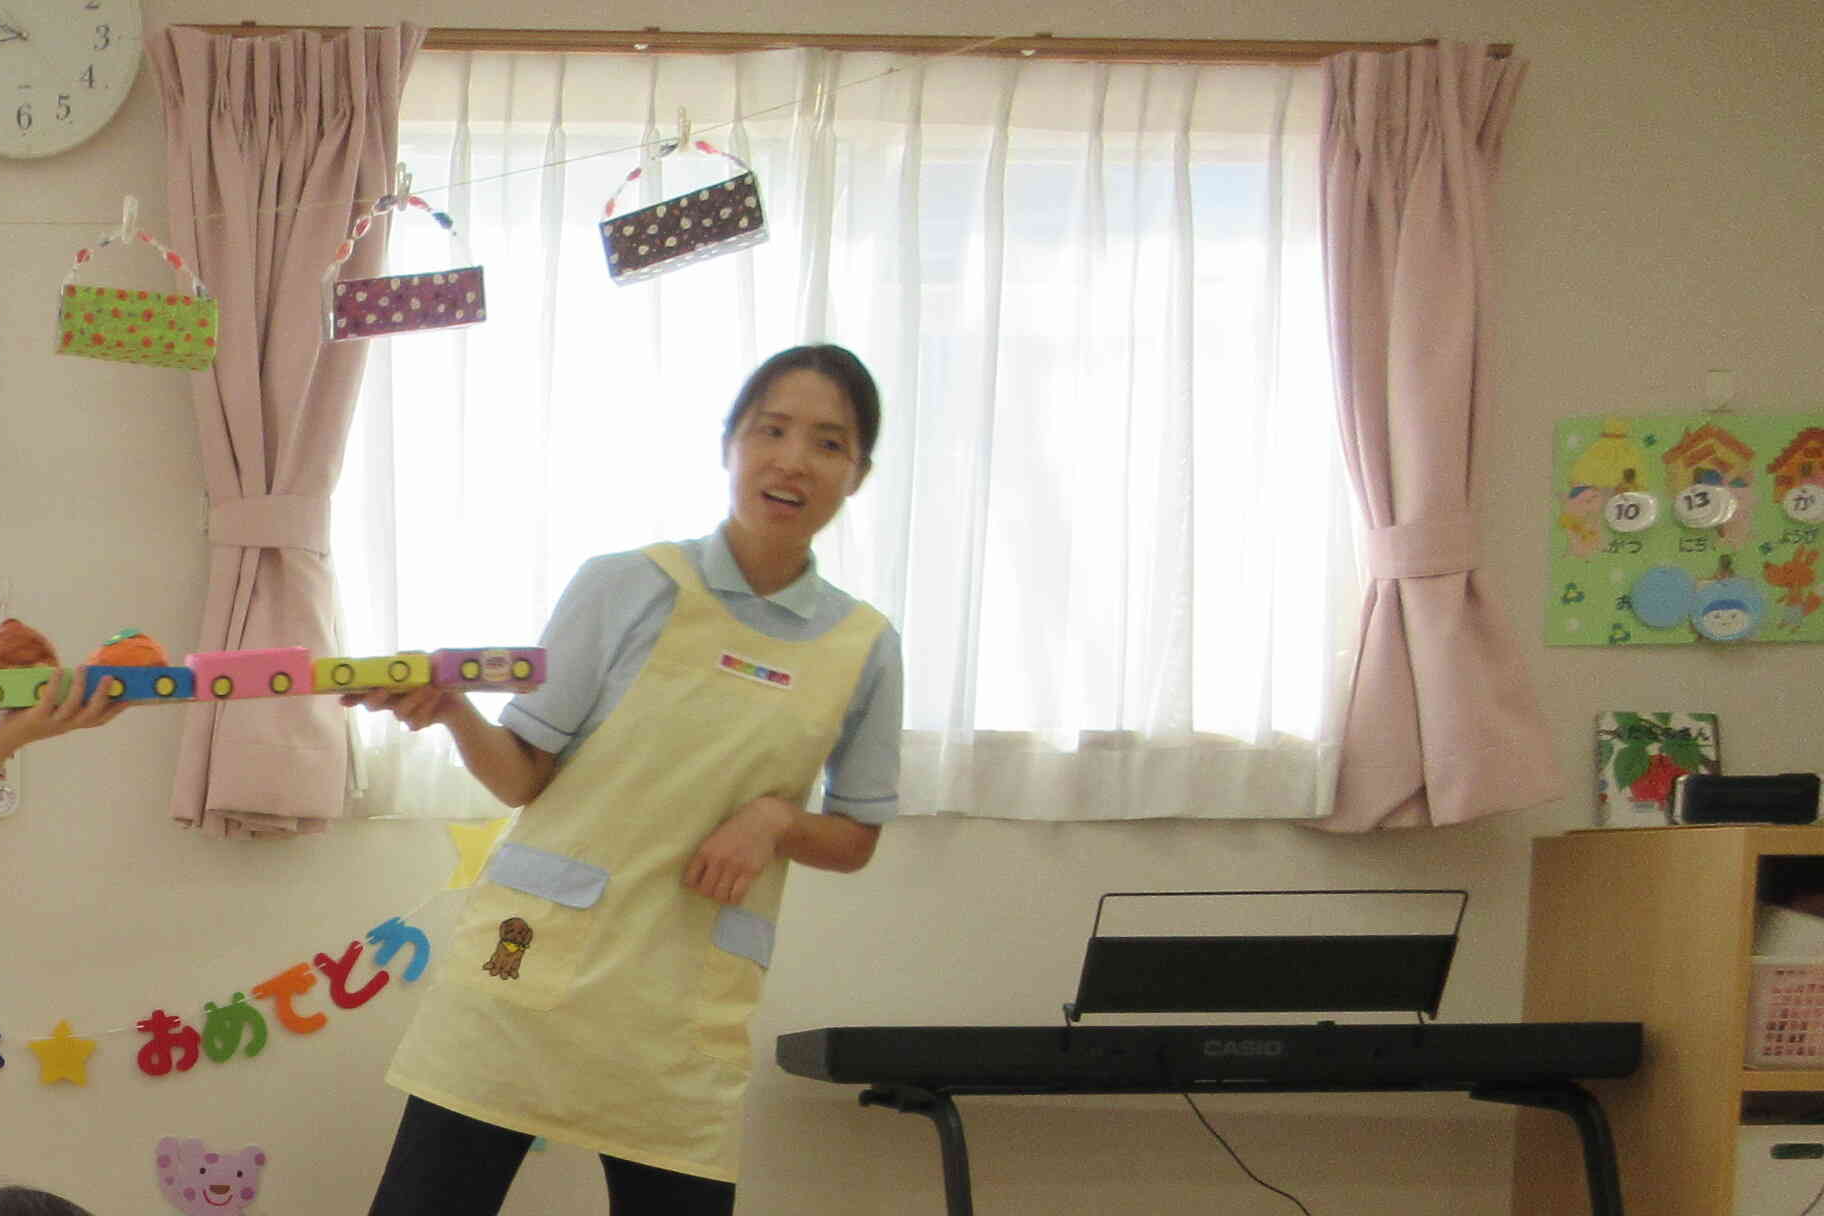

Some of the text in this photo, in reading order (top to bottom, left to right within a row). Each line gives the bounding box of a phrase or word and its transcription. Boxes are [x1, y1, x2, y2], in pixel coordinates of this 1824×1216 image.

[94, 24, 111, 50] 3
[80, 64, 96, 89] 4
[16, 104, 33, 131] 6
[56, 95, 72, 121] 5
[1614, 503, 1641, 521] 10
[1683, 492, 1710, 511] 13
[1202, 1039, 1284, 1057] CASIO
